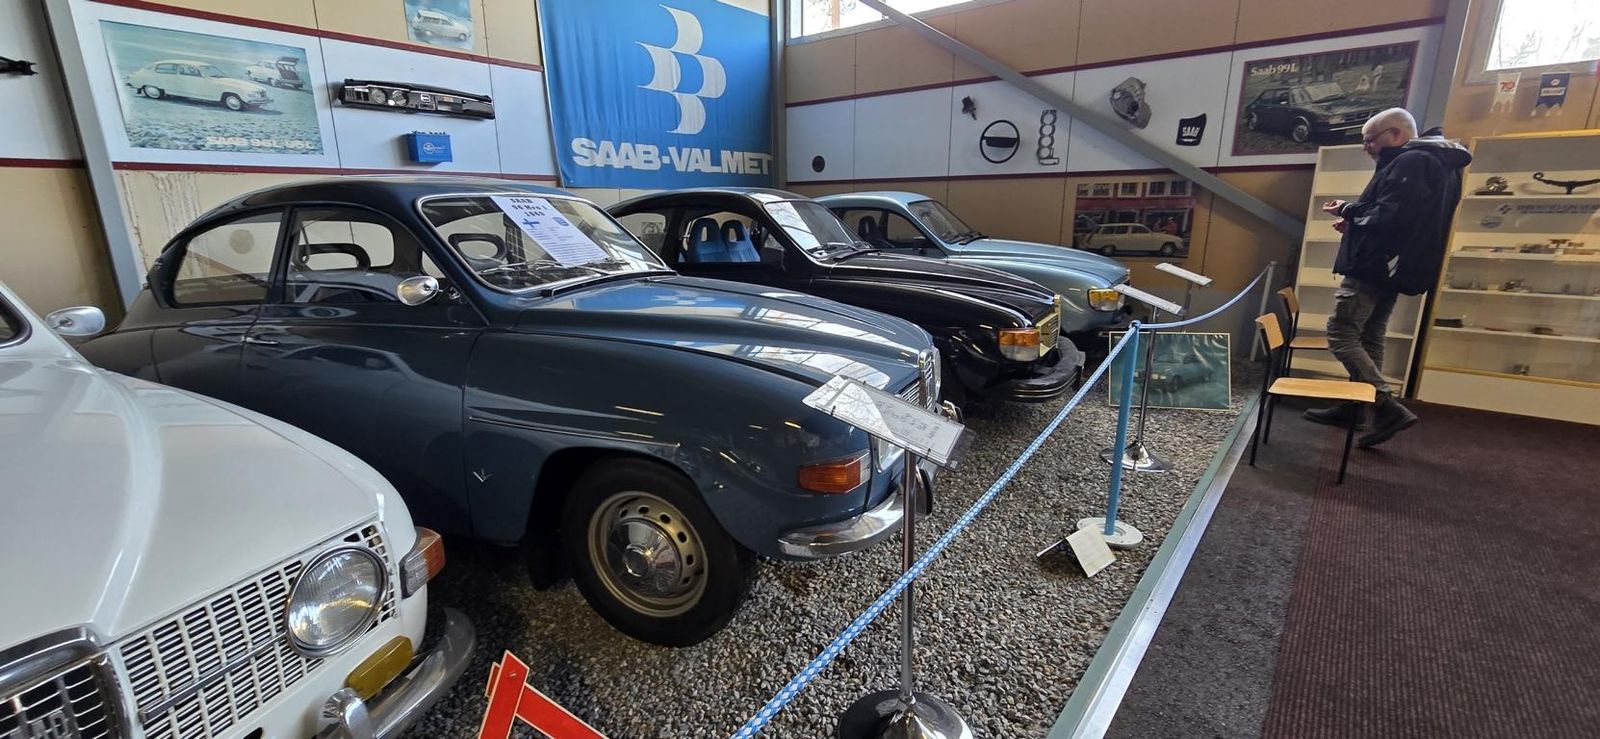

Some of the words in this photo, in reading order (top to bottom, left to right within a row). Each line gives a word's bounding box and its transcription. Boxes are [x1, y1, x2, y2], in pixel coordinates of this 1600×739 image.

[1251, 64, 1277, 77] Saab
[1182, 126, 1200, 137] SAAB
[571, 138, 774, 175] SAAB-VALMET
